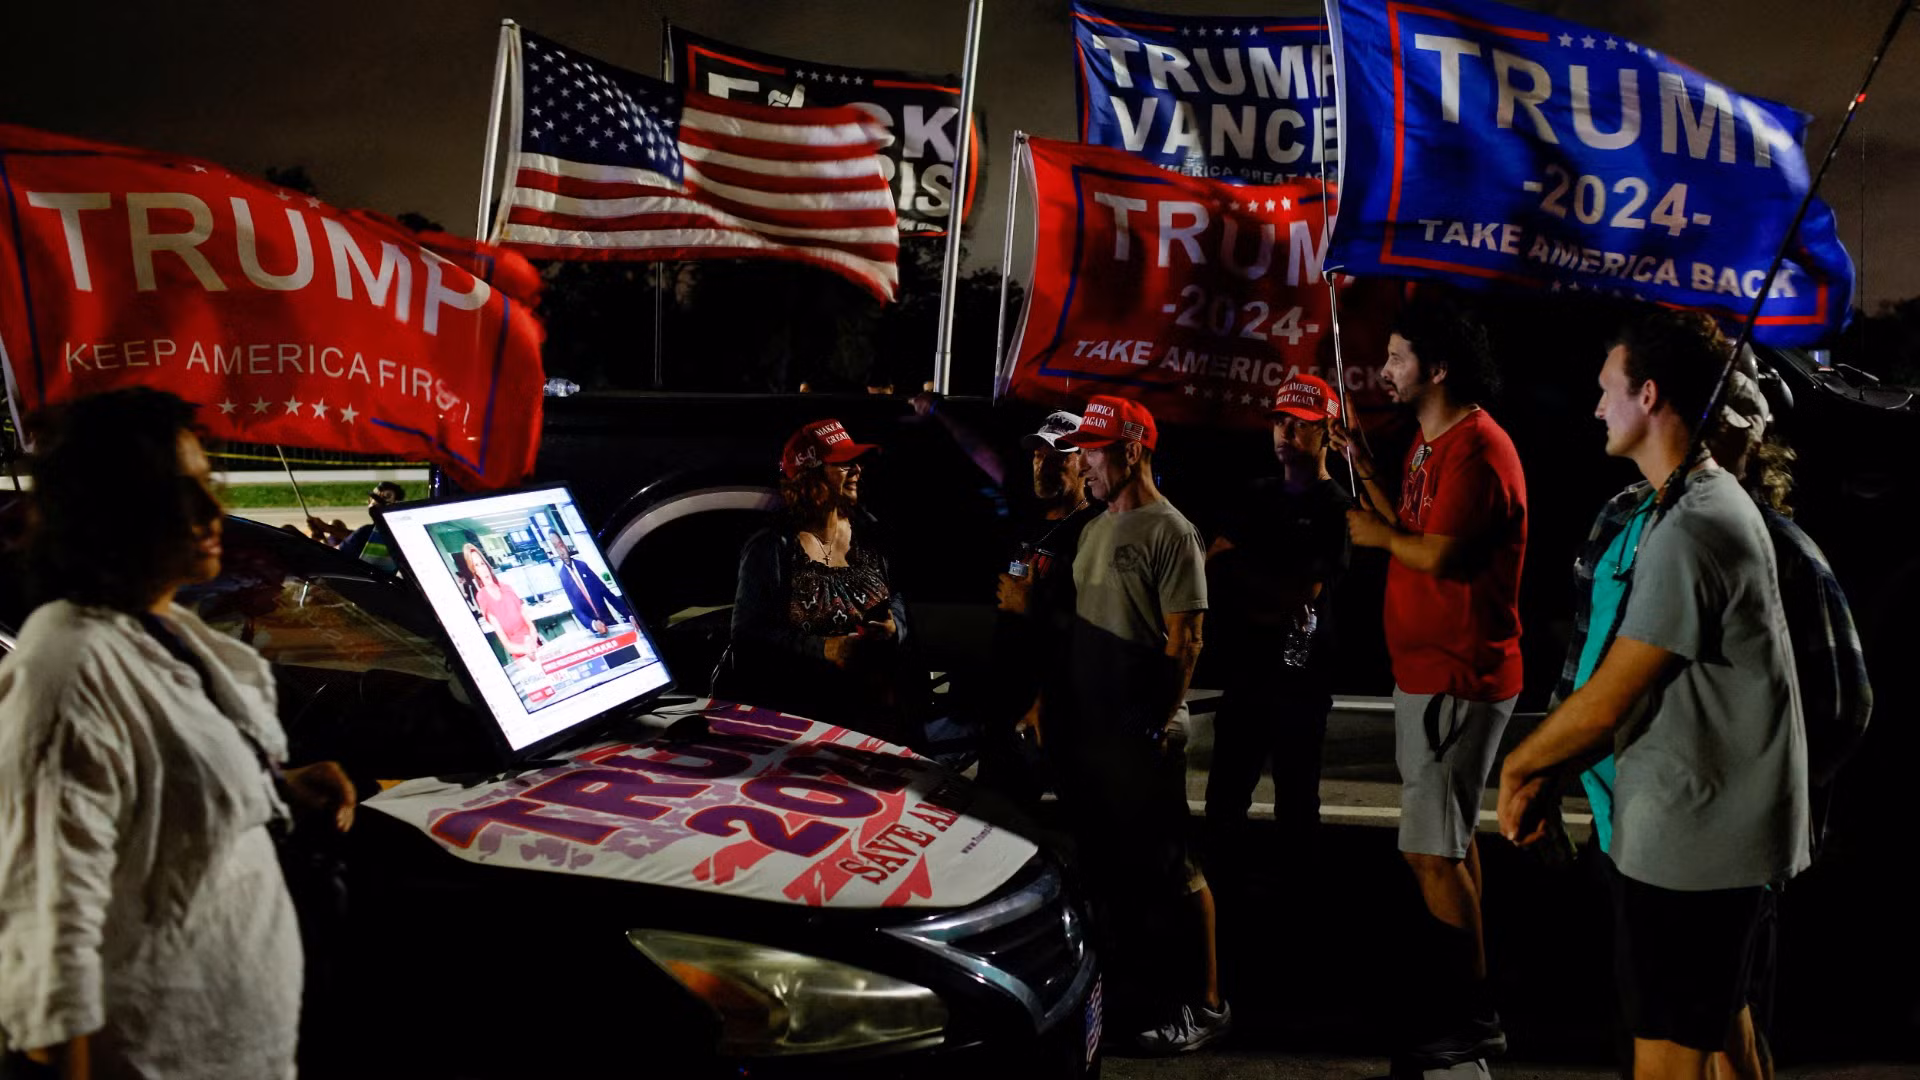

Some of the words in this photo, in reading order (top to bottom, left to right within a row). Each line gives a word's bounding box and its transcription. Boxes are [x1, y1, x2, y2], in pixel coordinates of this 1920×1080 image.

[1109, 95, 1338, 164] VANCE
[1415, 33, 1794, 168] TRUMP
[1523, 163, 1711, 236] -2024-
[26, 191, 491, 336] TRUMP
[1094, 192, 1337, 287] TRUM
[1418, 219, 1521, 255] TAKE
[1526, 234, 1680, 287] AMERICA
[1691, 258, 1800, 299] BACK
[1162, 284, 1320, 346] -2024-
[65, 338, 177, 373] KEEP
[186, 339, 371, 385] AMERICA
[1073, 339, 1153, 365] TAKE
[1308, 365, 1388, 392] ACK
[814, 423, 837, 436] MAKE
[837, 822, 937, 886] SAVE
